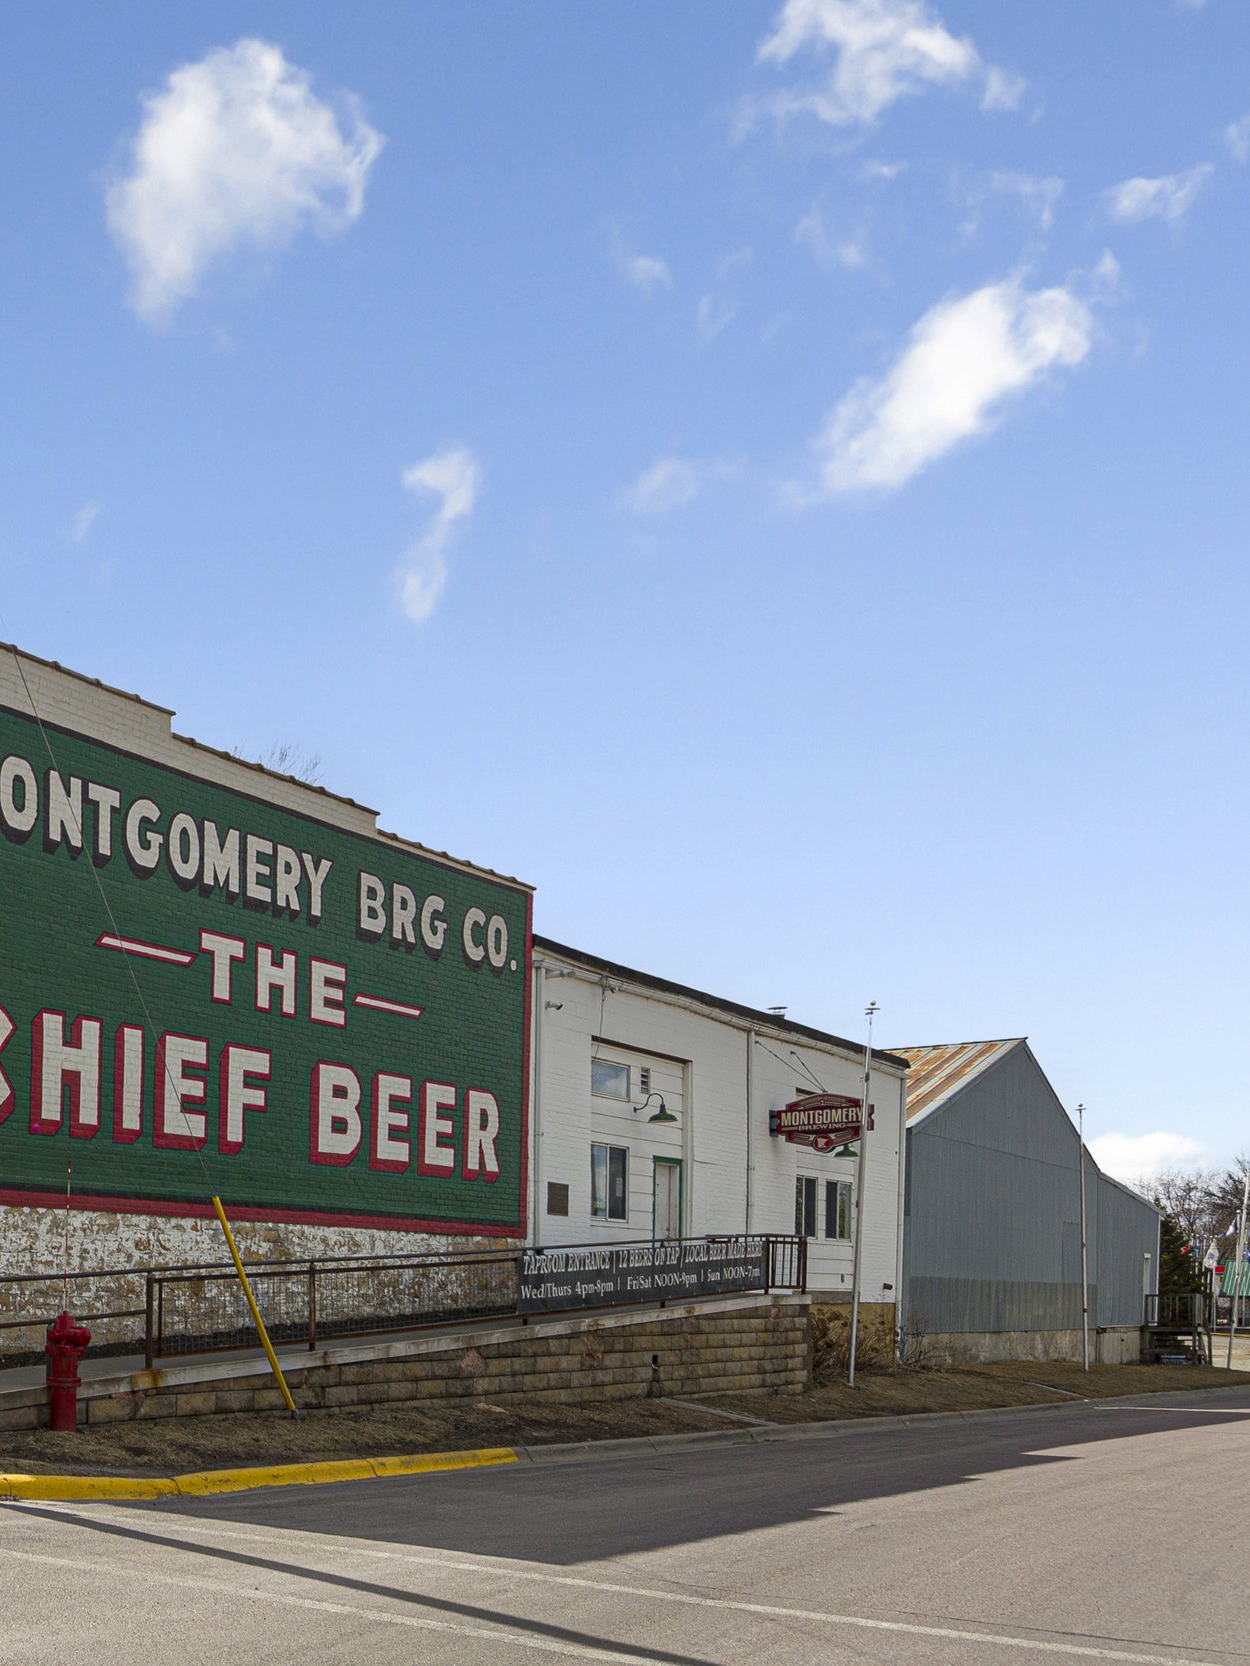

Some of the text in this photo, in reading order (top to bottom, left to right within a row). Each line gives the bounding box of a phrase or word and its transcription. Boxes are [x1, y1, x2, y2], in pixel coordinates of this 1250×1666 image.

[357, 871, 448, 957] BRG
[461, 906, 518, 973] CO.
[199, 928, 348, 1028] THE
[310, 1061, 501, 1182] BEER
[781, 1107, 862, 1126] MONTGOMERY
[798, 1122, 846, 1131] BREWING
[523, 1253, 566, 1275] TAPROOM
[568, 1251, 610, 1272] ENTRANCE
[619, 1249, 628, 1268] 12
[629, 1248, 653, 1268] BEERS
[654, 1247, 666, 1266] ON
[666, 1246, 680, 1265] TAP
[685, 1244, 708, 1263] LOCAL
[709, 1242, 726, 1261] BEER
[727, 1241, 746, 1259] MADE
[746, 1241, 763, 1258] HERE
[575, 1279, 614, 1298] 4pm-8pm
[654, 1272, 697, 1288] NOON-9pm
[707, 1269, 720, 1282] Sun
[723, 1265, 760, 1281] NOON-7pm
